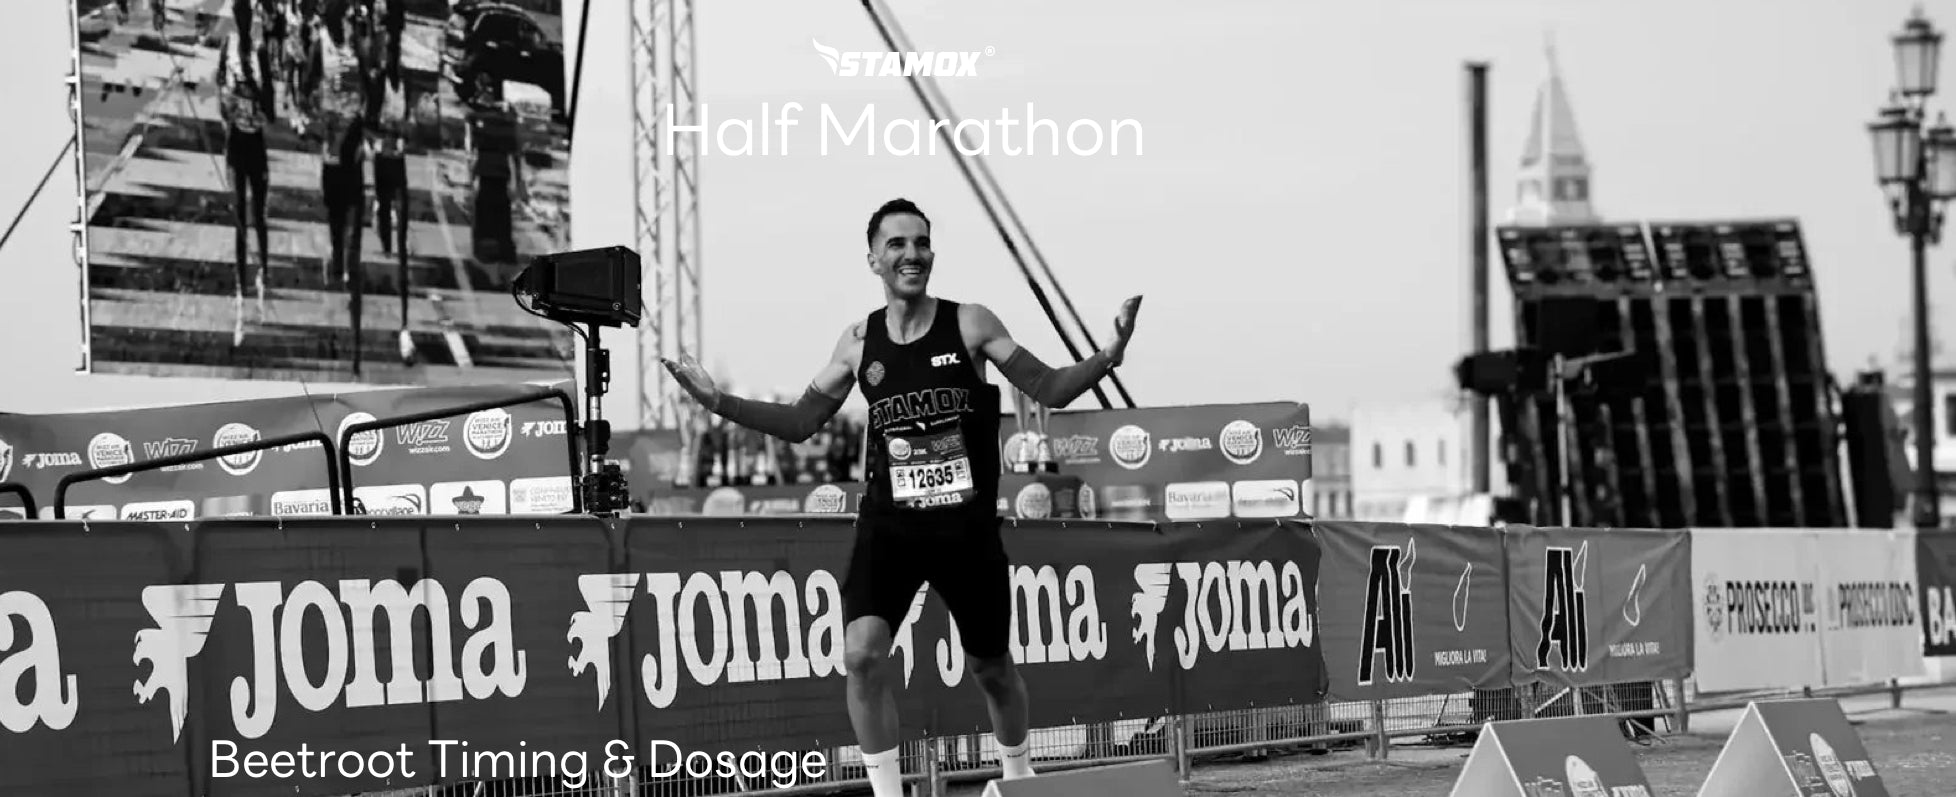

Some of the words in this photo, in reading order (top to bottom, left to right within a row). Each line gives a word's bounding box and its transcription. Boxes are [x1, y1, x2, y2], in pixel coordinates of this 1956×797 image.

[869, 390, 974, 429] STAMOX
[36, 452, 82, 469] Joma
[909, 465, 954, 489] 12635
[273, 499, 329, 515] Bavaria
[1173, 559, 1313, 670] Joma
[1726, 579, 1800, 635] PROSECCO
[642, 570, 847, 709] Joma
[1635, 641, 1645, 656] LA
[230, 576, 526, 739] Joma
[1434, 650, 1464, 667] MIGLIORA
[1464, 649, 1473, 664] LA
